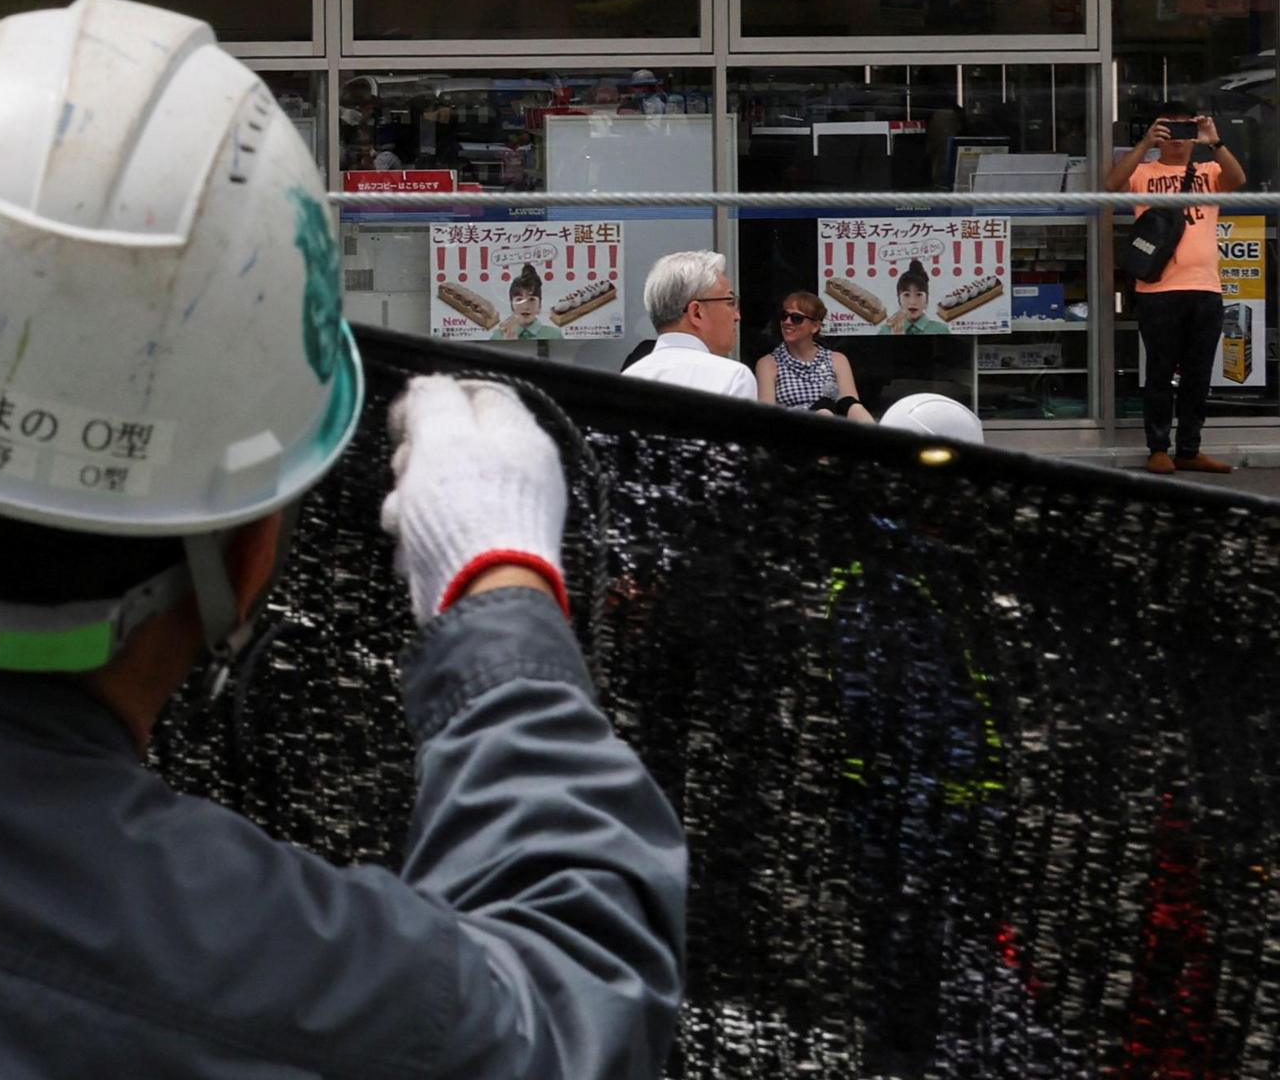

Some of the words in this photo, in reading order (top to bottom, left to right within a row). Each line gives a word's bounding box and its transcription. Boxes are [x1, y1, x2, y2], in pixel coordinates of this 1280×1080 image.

[831, 312, 855, 321] New
[443, 317, 467, 326] New
[81, 419, 155, 460] O型
